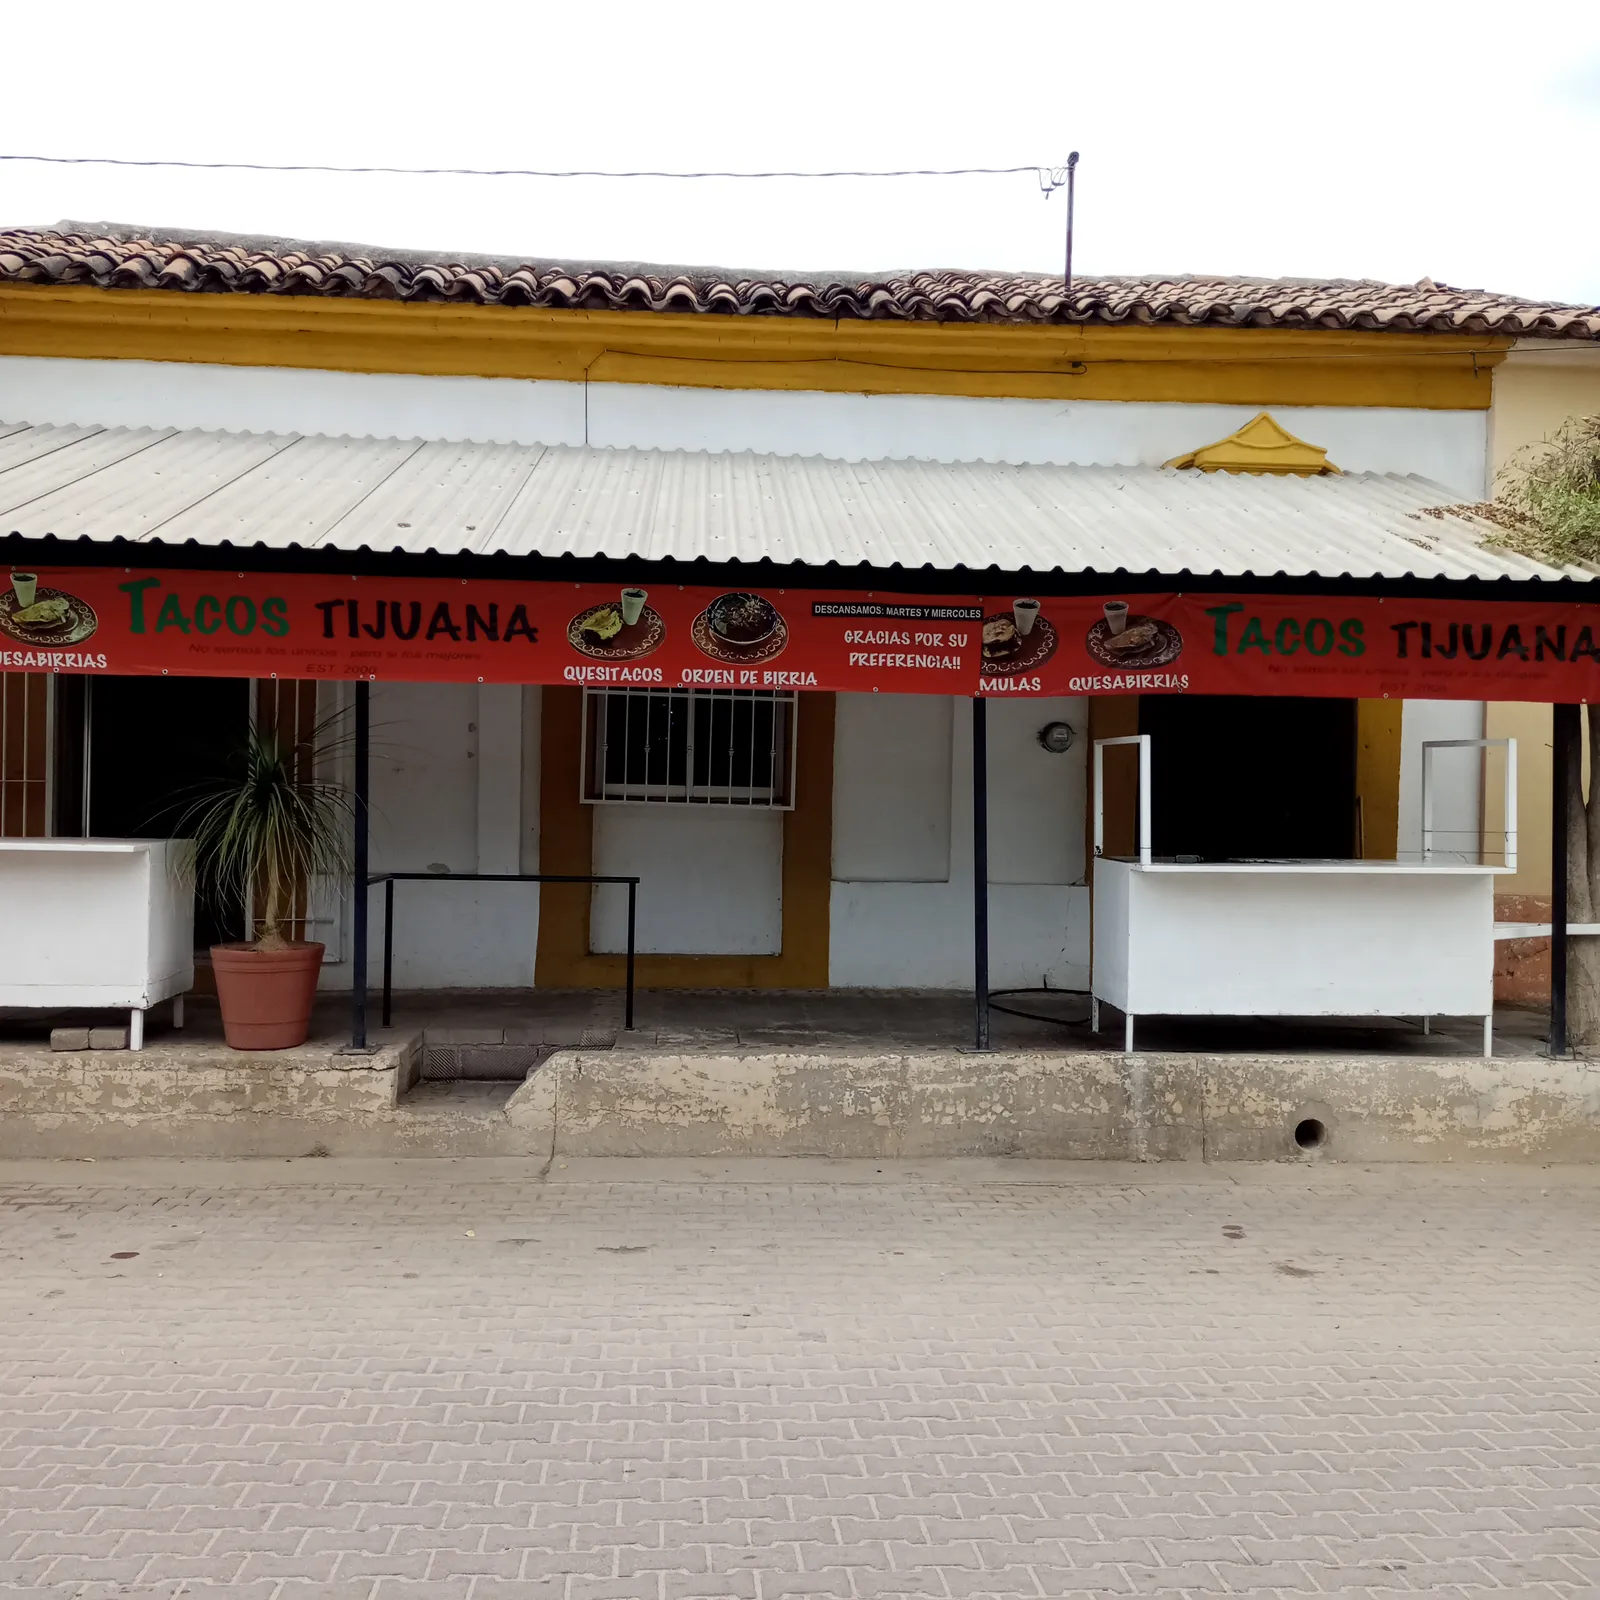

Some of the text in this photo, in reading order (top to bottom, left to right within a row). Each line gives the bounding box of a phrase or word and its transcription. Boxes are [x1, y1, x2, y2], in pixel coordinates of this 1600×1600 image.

[118, 576, 539, 643] TACOS TIJUANA
[815, 604, 981, 619] DESCANSAMOS: MARTES Y MIERCOLES
[844, 630, 967, 647] GRACIAS POR SU
[1204, 602, 1600, 663] TACOS TIJUANA
[0, 651, 107, 669] ESABIRRIAS
[306, 663, 336, 673] EST
[849, 652, 961, 670] PREFERENCIA!!
[564, 666, 663, 682] QUESITACOS
[681, 668, 817, 686] ORDEN DE BIRRIA
[1069, 674, 1189, 691] QUESABIRRIAS
[979, 677, 1041, 692] MULAS
